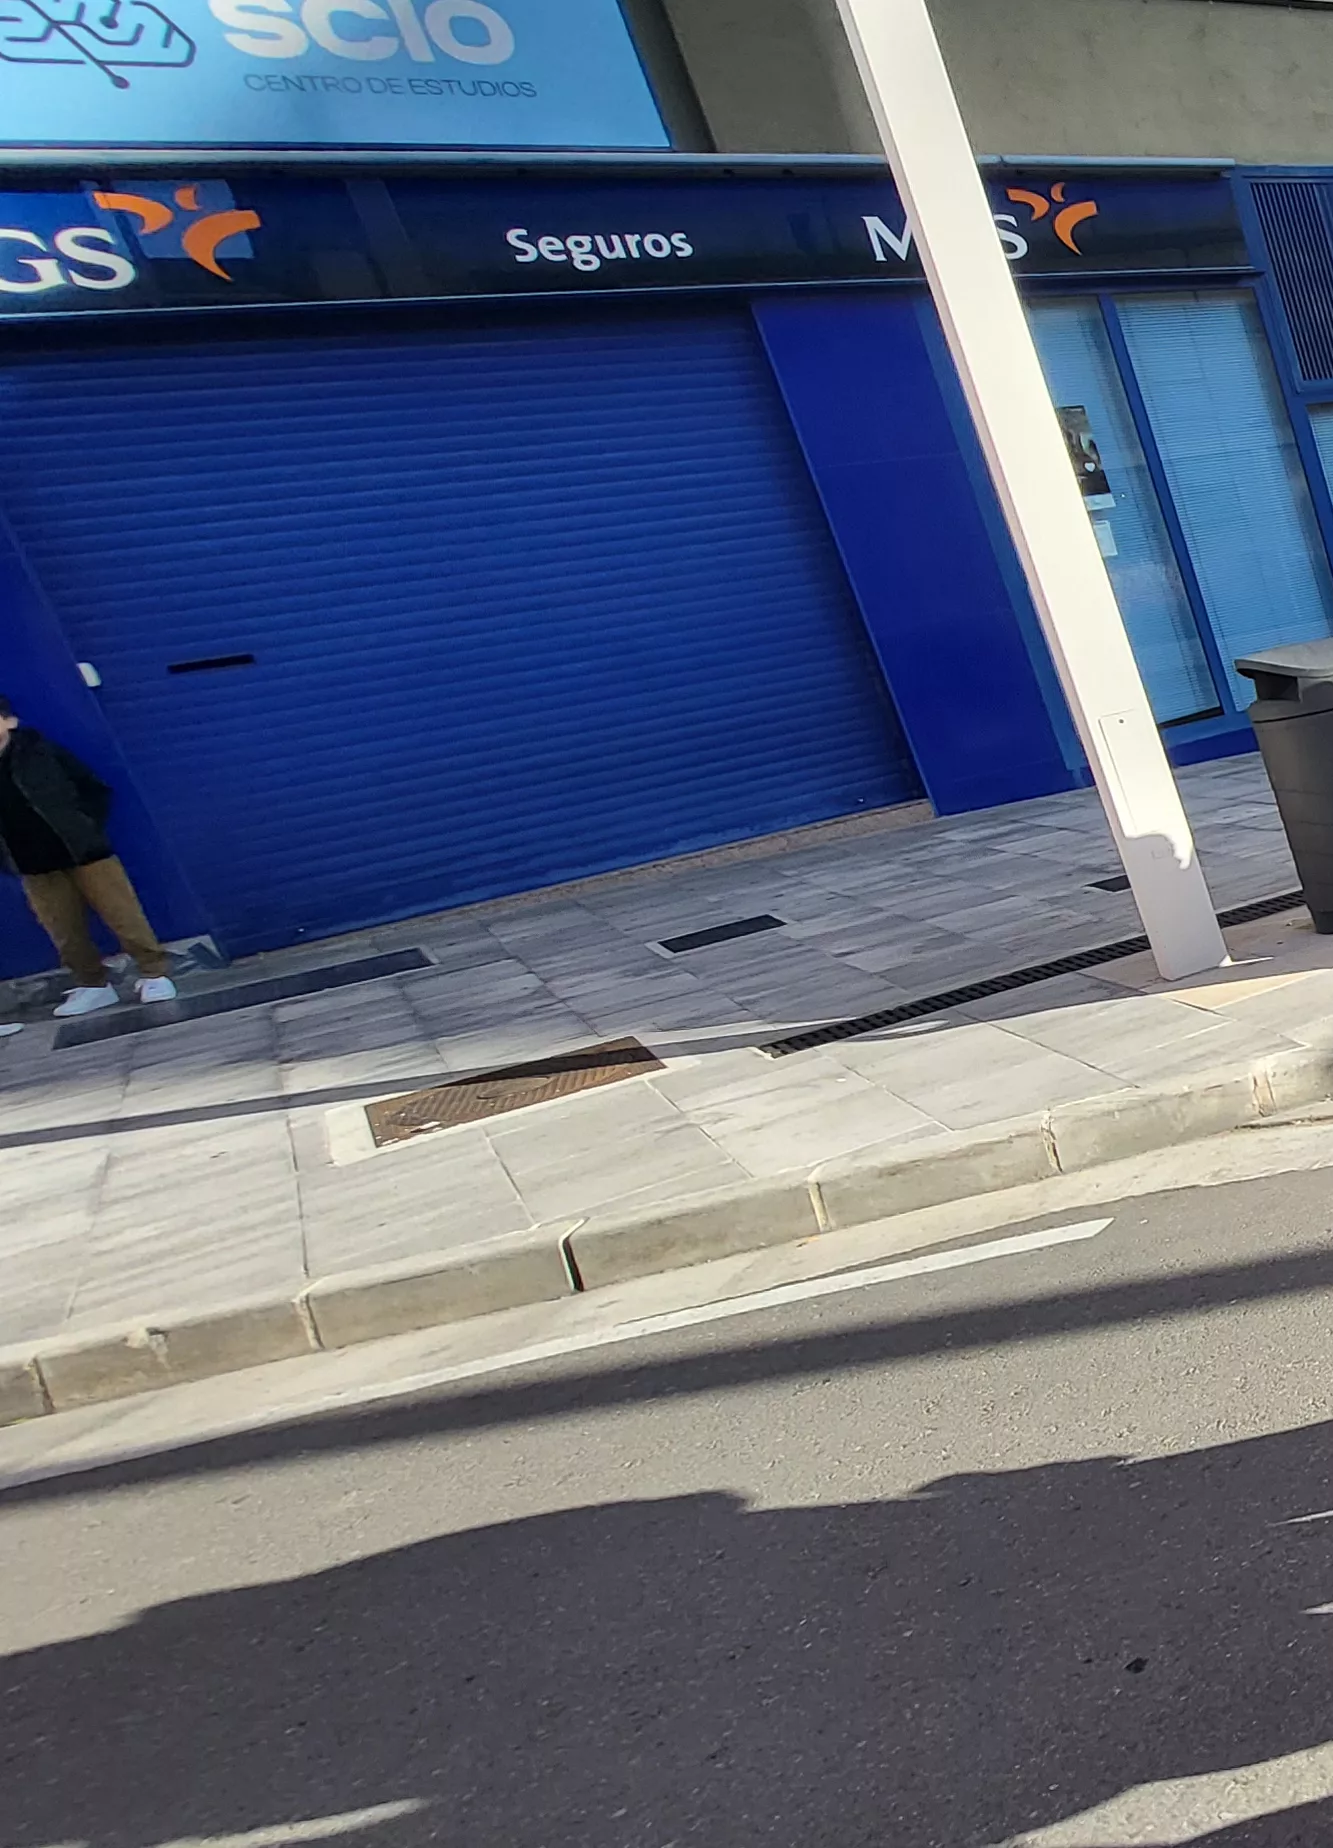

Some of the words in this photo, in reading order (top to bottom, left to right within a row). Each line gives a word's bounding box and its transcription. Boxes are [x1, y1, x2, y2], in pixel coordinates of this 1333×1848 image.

[244, 74, 363, 94] CENTRO
[368, 77, 404, 95] DE
[408, 78, 537, 98] ESTUDIOS
[505, 227, 694, 272] Seguros
[861, 214, 1028, 261] MS
